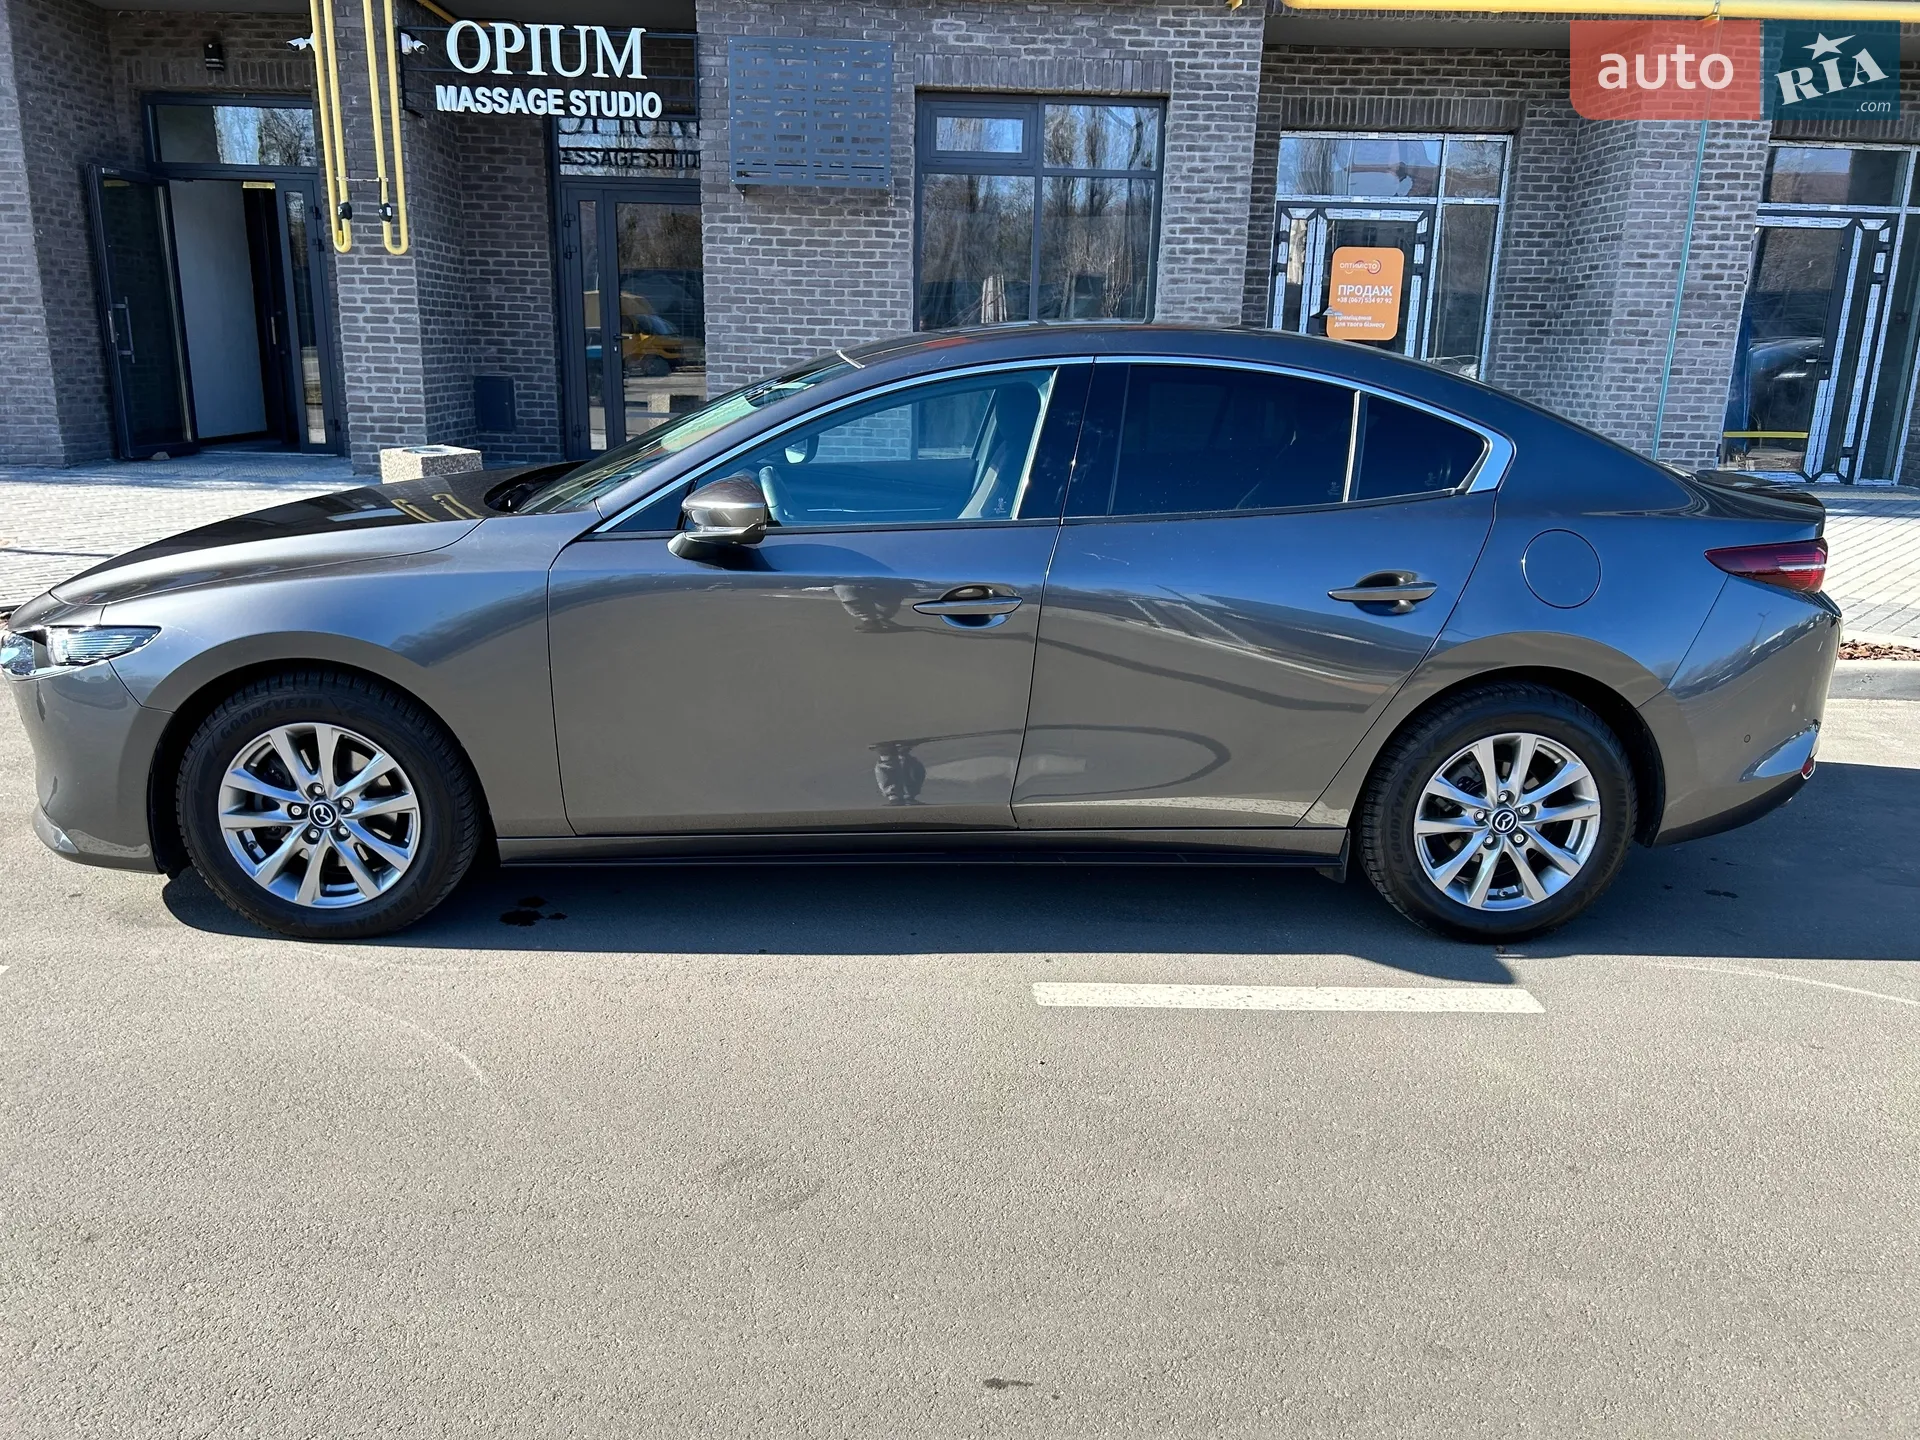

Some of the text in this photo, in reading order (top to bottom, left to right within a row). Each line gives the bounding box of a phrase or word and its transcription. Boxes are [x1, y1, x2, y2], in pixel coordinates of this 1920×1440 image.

[446, 20, 648, 80] OPIUM
[435, 84, 663, 119] MASSAGE STUDIO
[1338, 285, 1393, 298] ПРОДАЖ
